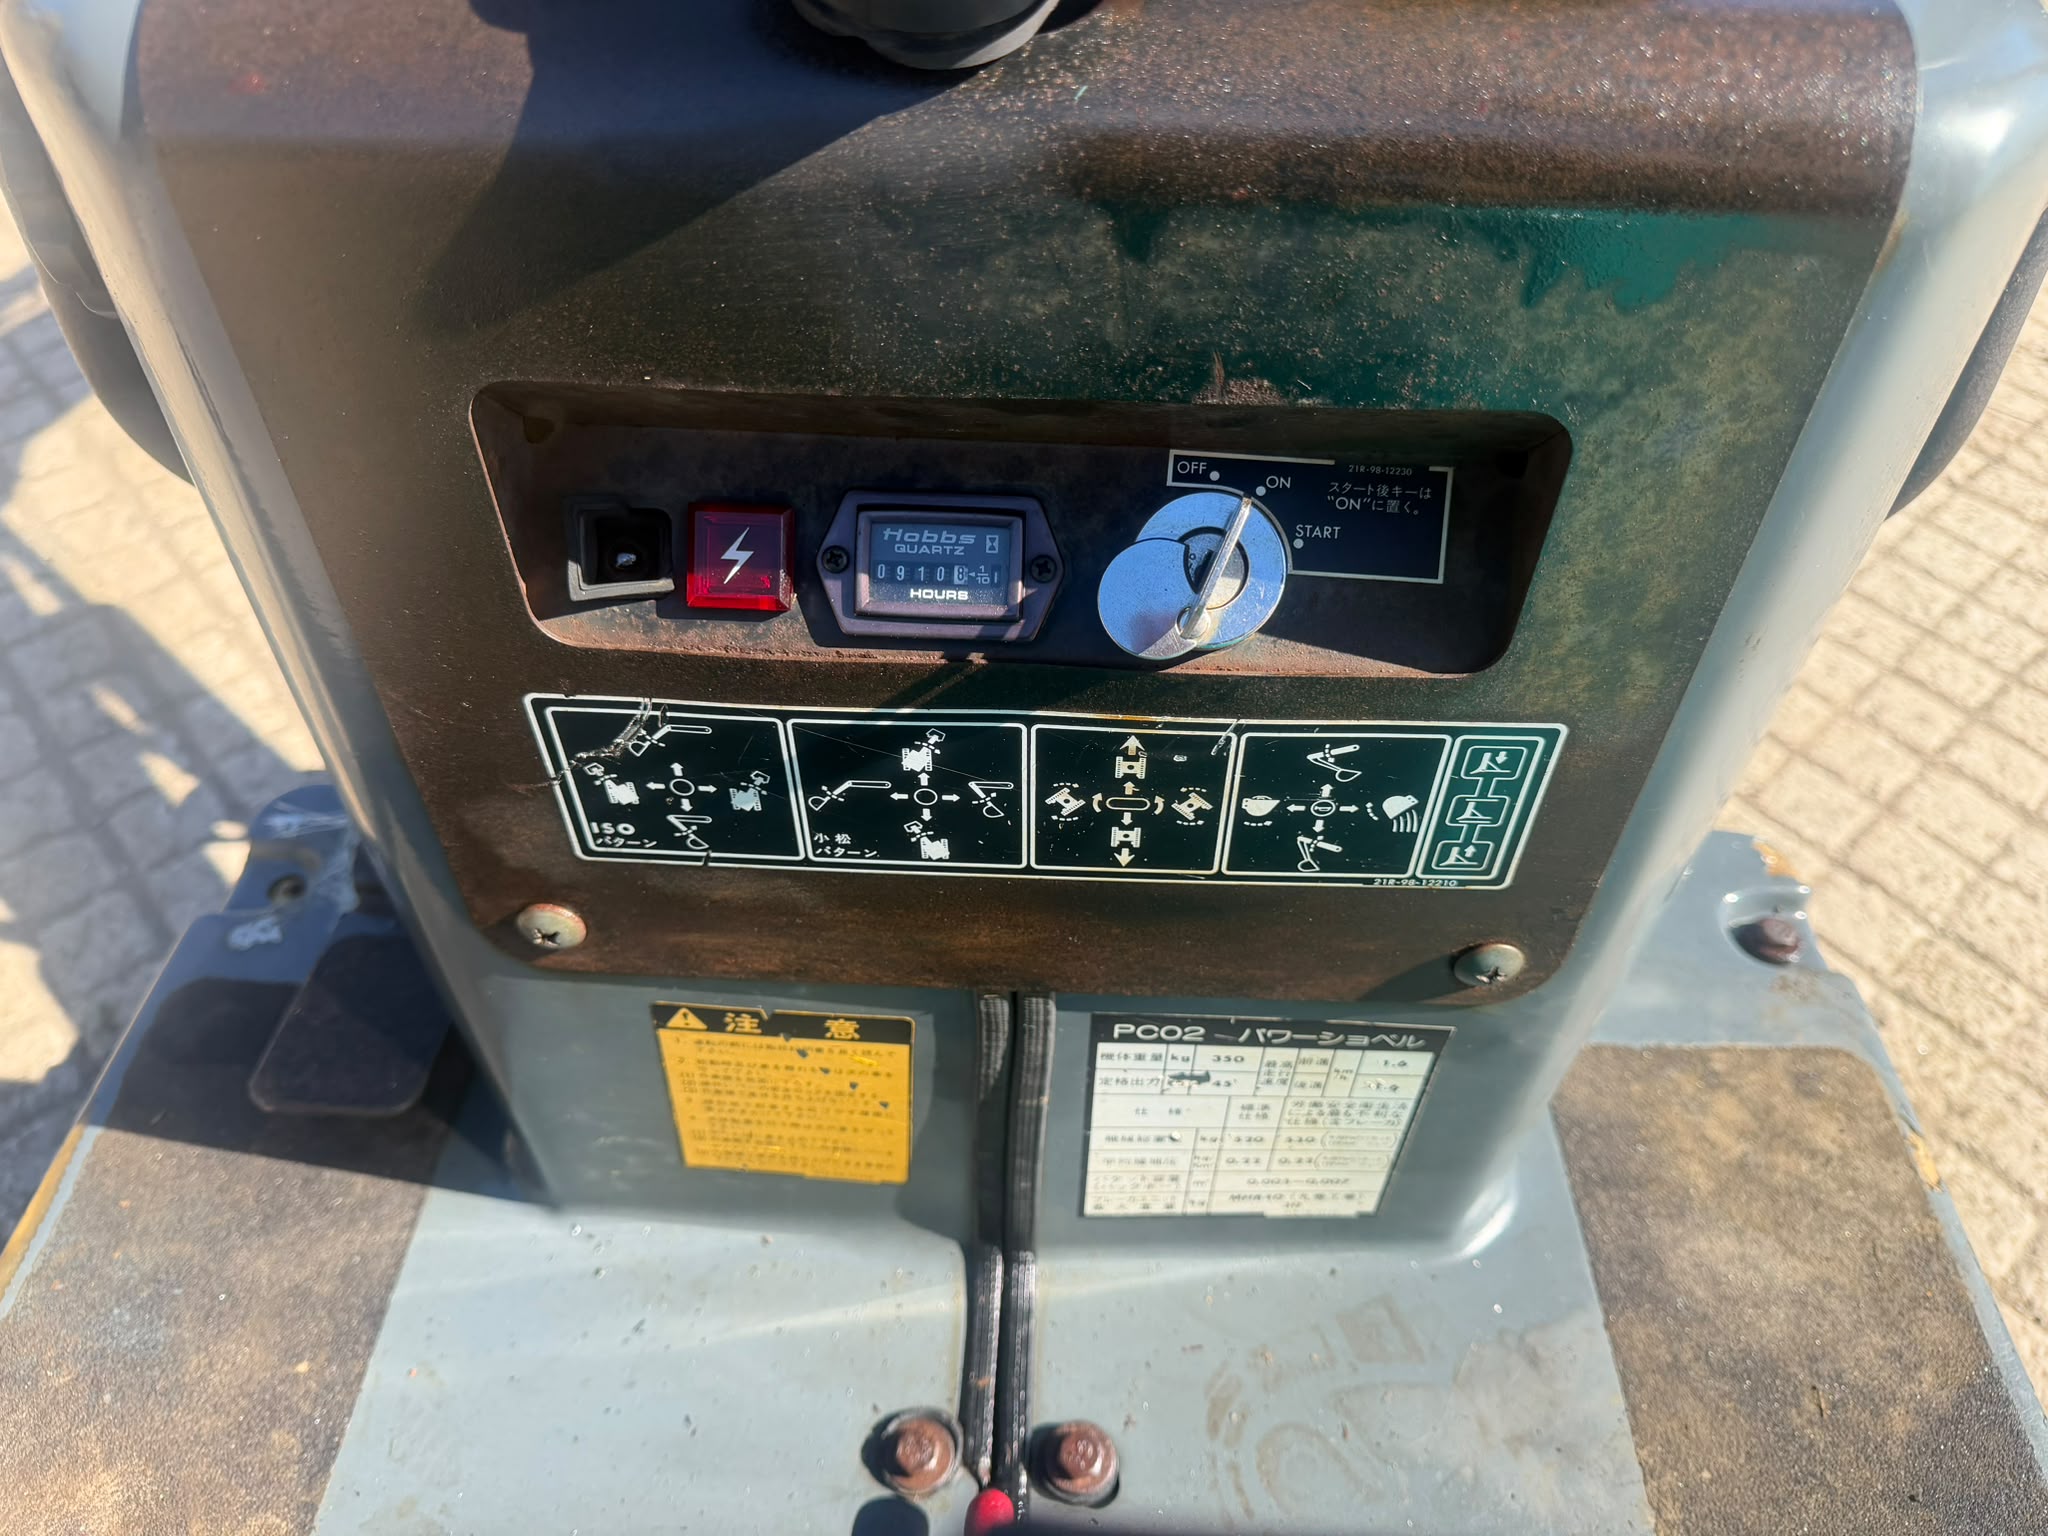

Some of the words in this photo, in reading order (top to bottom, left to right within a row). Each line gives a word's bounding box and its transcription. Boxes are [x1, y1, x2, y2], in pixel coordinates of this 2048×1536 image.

[1177, 461, 1207, 474] OFF
[1265, 475, 1291, 489] ON
[1328, 481, 1432, 500] スタート後キーは
[883, 527, 976, 545] Hobbs
[1295, 524, 1342, 539] START
[894, 543, 965, 556] QUARTZ
[909, 588, 969, 601] HOURS
[590, 821, 636, 836] ISO
[595, 835, 658, 849] パターン
[815, 845, 878, 859] パターン
[1373, 878, 1458, 888] 21R-98-12210
